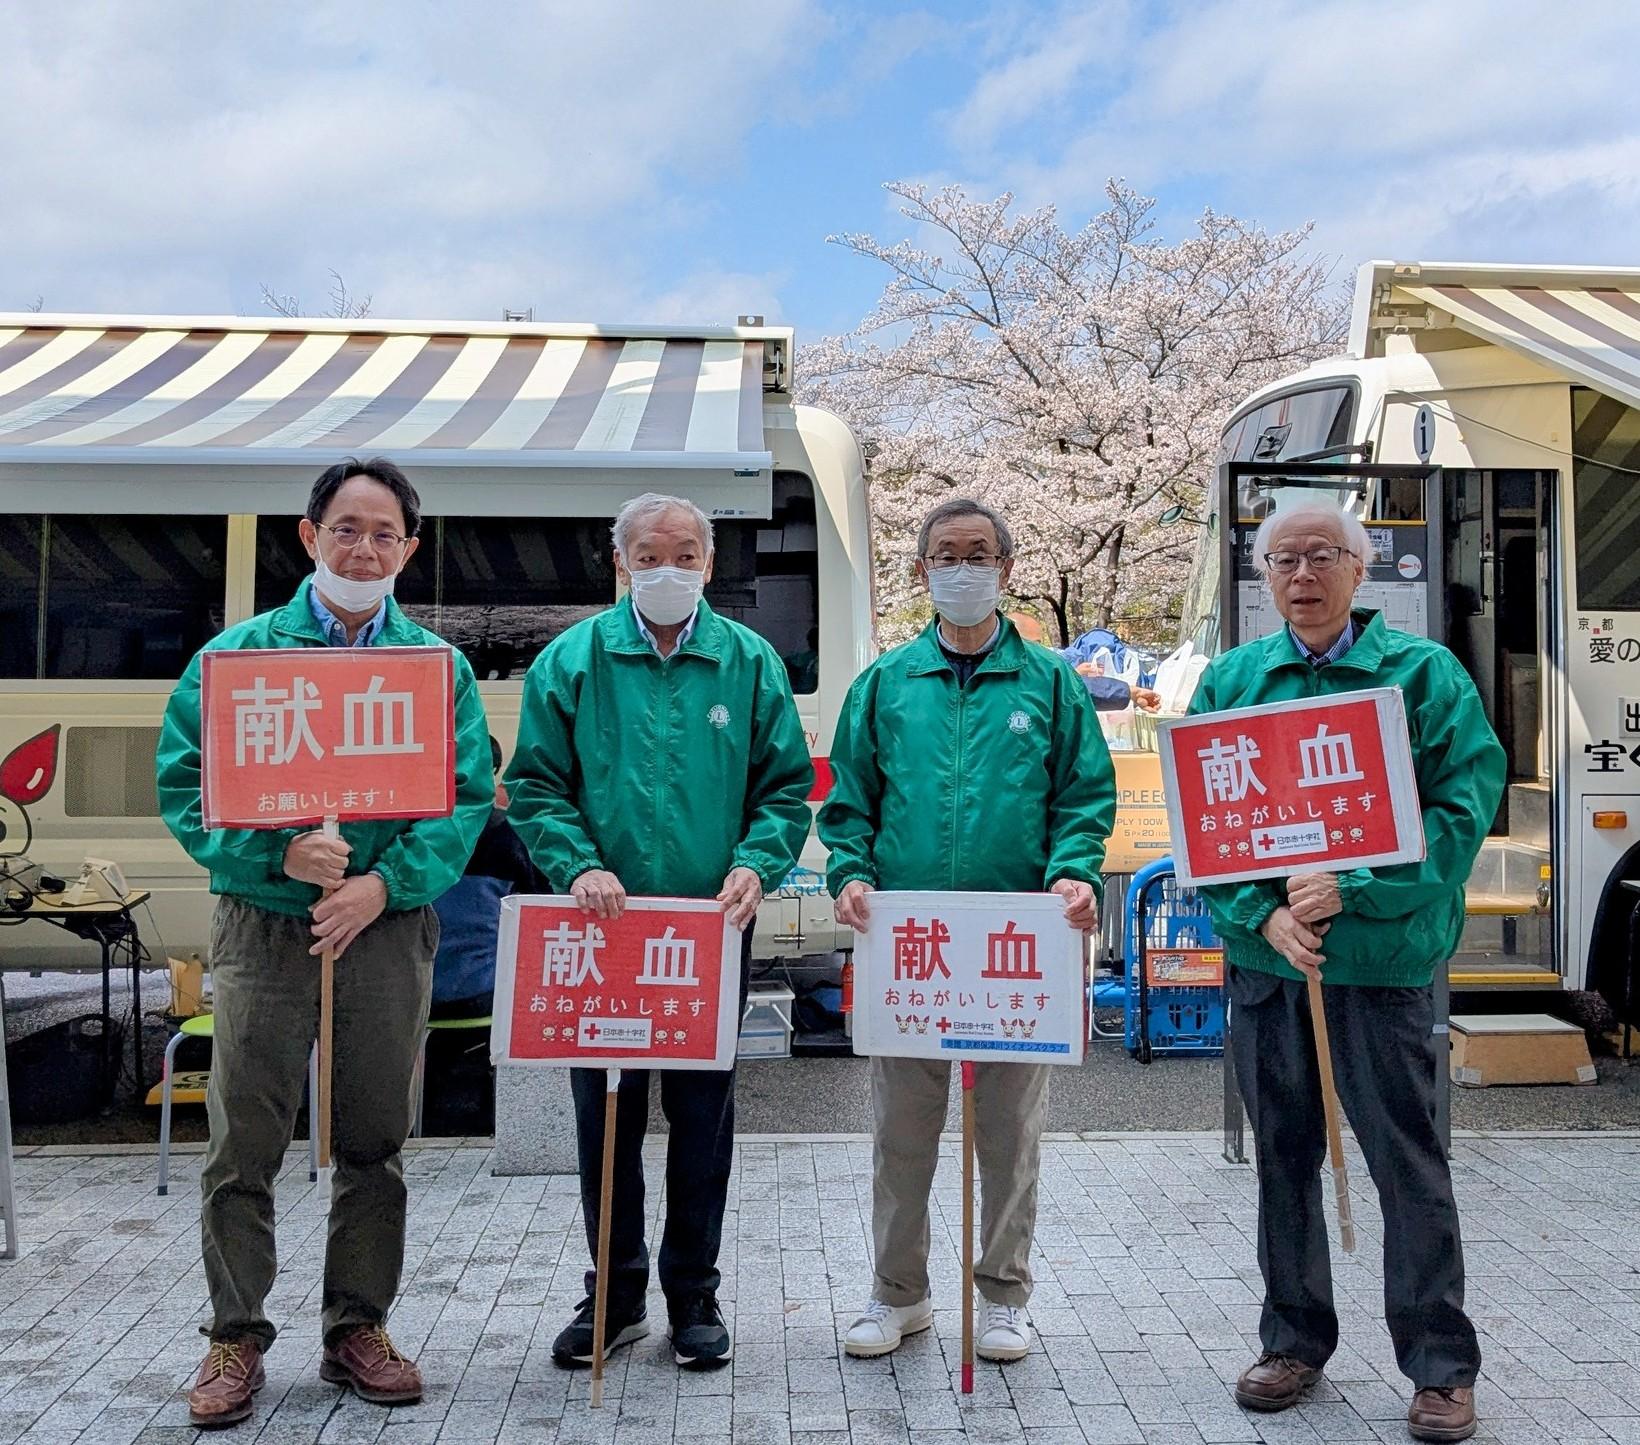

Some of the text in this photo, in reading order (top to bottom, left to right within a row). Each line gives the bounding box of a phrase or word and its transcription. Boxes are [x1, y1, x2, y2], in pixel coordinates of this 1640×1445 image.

[1577, 617, 1614, 631] 京都
[1589, 637, 1640, 664] 愛の
[231, 675, 425, 767] 献血
[1197, 723, 1365, 806] 献血
[1199, 792, 1377, 833] おねがいします
[541, 921, 700, 988] 献血
[892, 917, 1043, 981] 献血
[529, 993, 707, 1017] おねがいします
[885, 987, 1051, 1011] おねがいします
